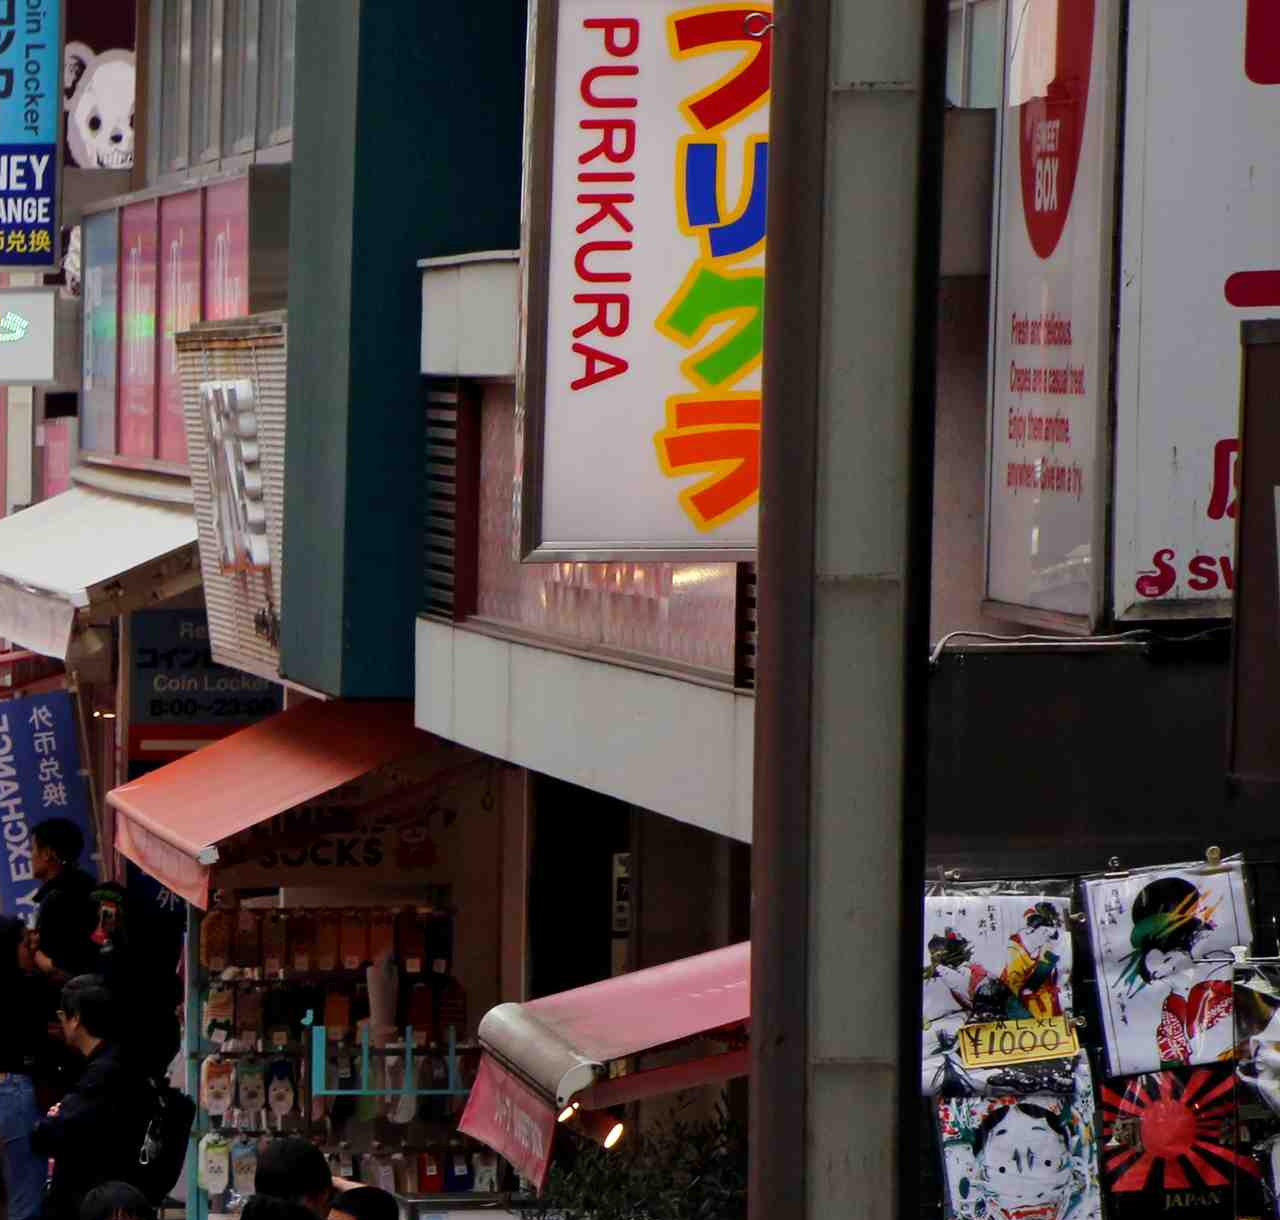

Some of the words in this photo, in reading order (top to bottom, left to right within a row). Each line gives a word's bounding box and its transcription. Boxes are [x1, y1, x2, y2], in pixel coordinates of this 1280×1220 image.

[24, 43, 46, 135] Locker
[570, 18, 640, 391] PURIKURA
[1033, 156, 1059, 213] BOX
[152, 674, 200, 692] Coin
[965, 1026, 1061, 1060] ¥1000
